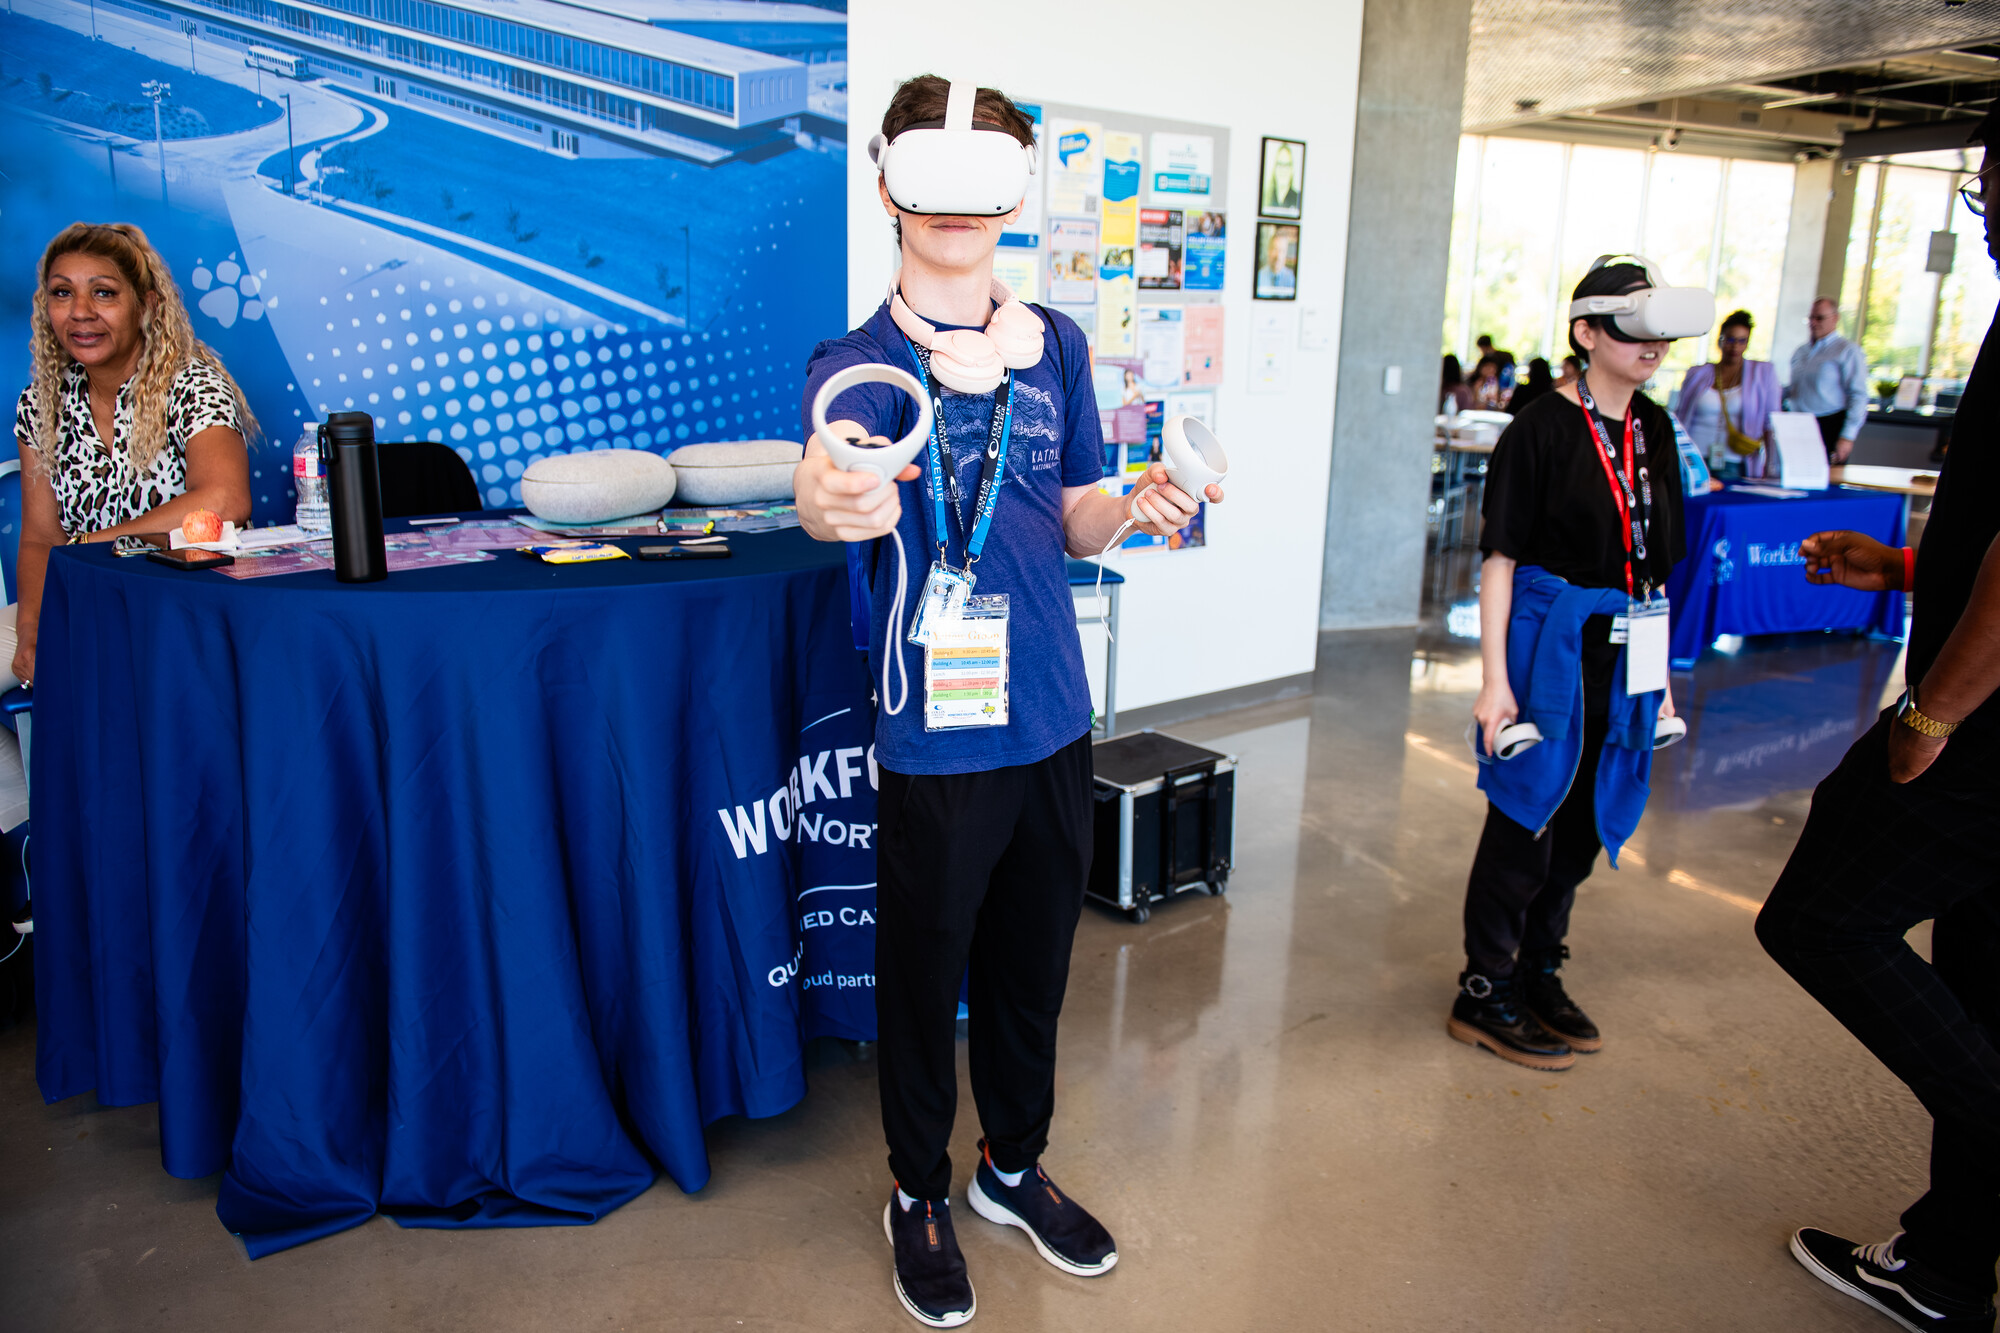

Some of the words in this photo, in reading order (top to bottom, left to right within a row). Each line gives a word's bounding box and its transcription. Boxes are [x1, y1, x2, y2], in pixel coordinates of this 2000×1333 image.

[991, 404, 1001, 437] COLLIN
[996, 405, 1006, 438] COLLEGE
[930, 434, 944, 502] MAVENIR
[976, 478, 988, 511] COLLIN
[983, 453, 1004, 518] MAVENIR
[797, 813, 878, 849] NOR
[839, 907, 877, 926] CA
